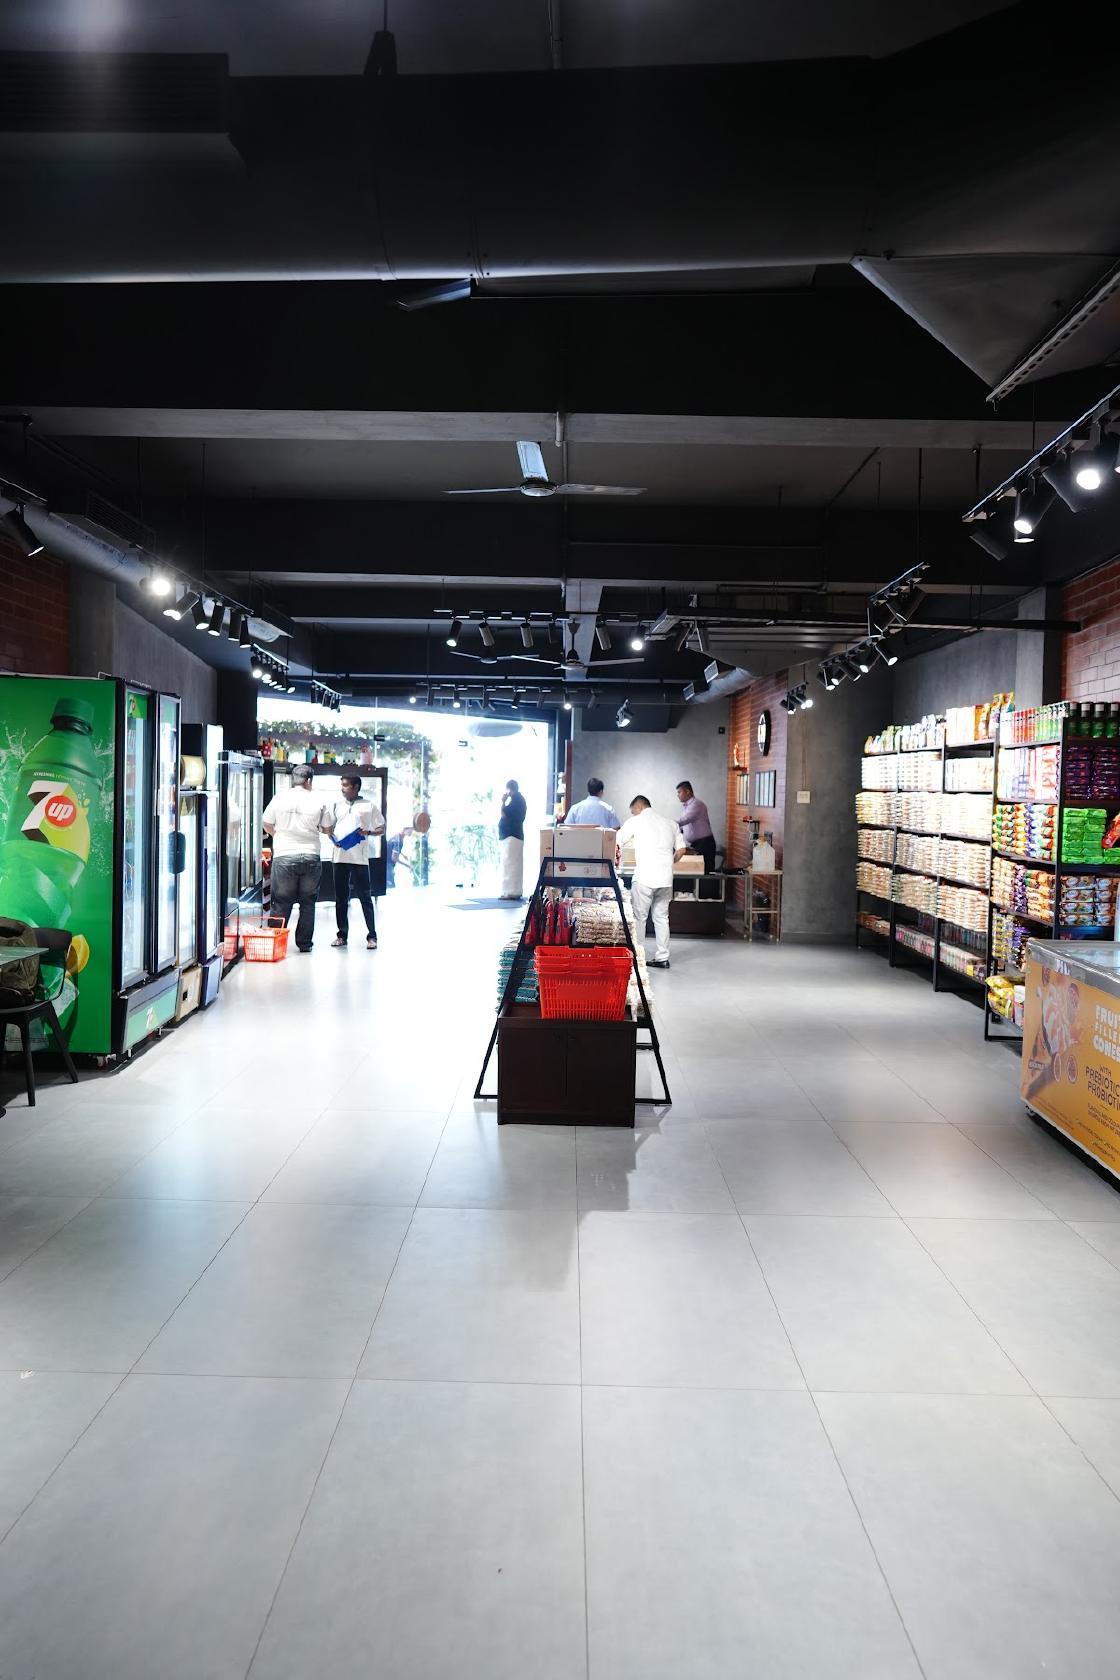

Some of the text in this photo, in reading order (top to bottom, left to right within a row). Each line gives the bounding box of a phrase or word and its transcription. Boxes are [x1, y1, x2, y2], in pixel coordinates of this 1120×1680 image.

[1095, 1004, 1120, 1030] FRUI
[1093, 1021, 1120, 1047] FILLE
[1087, 1081, 1120, 1111] PROBIOTI
